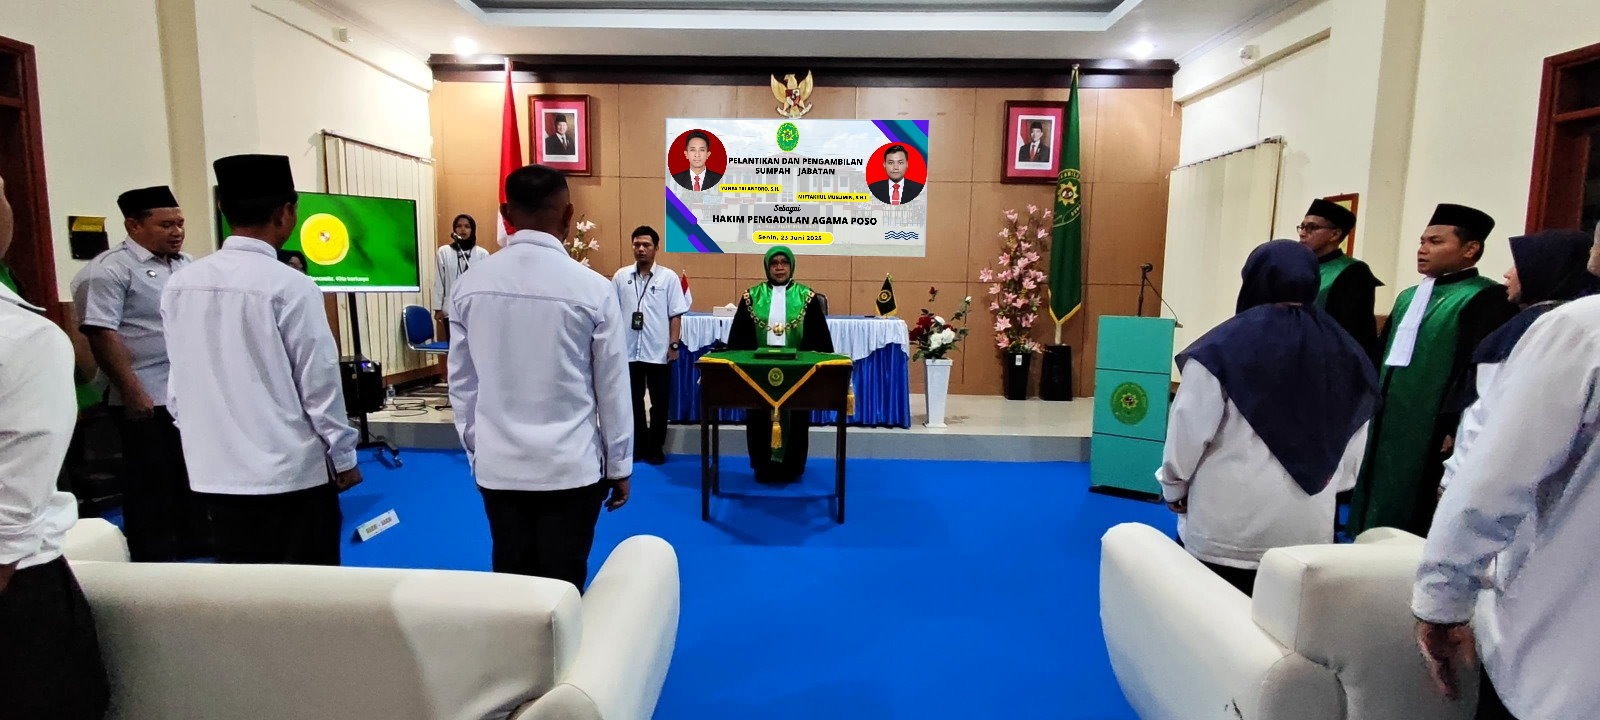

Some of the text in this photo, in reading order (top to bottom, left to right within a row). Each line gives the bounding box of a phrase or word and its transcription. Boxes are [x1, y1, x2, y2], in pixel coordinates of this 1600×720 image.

[728, 157, 863, 166] PELANTIKAN DAN PENGAMBILAN
[755, 167, 835, 176] SUMPAH JABATAN
[773, 204, 802, 215] Sebagai
[712, 214, 878, 226] HAKIM PENGADILAN AGAMA POSO
